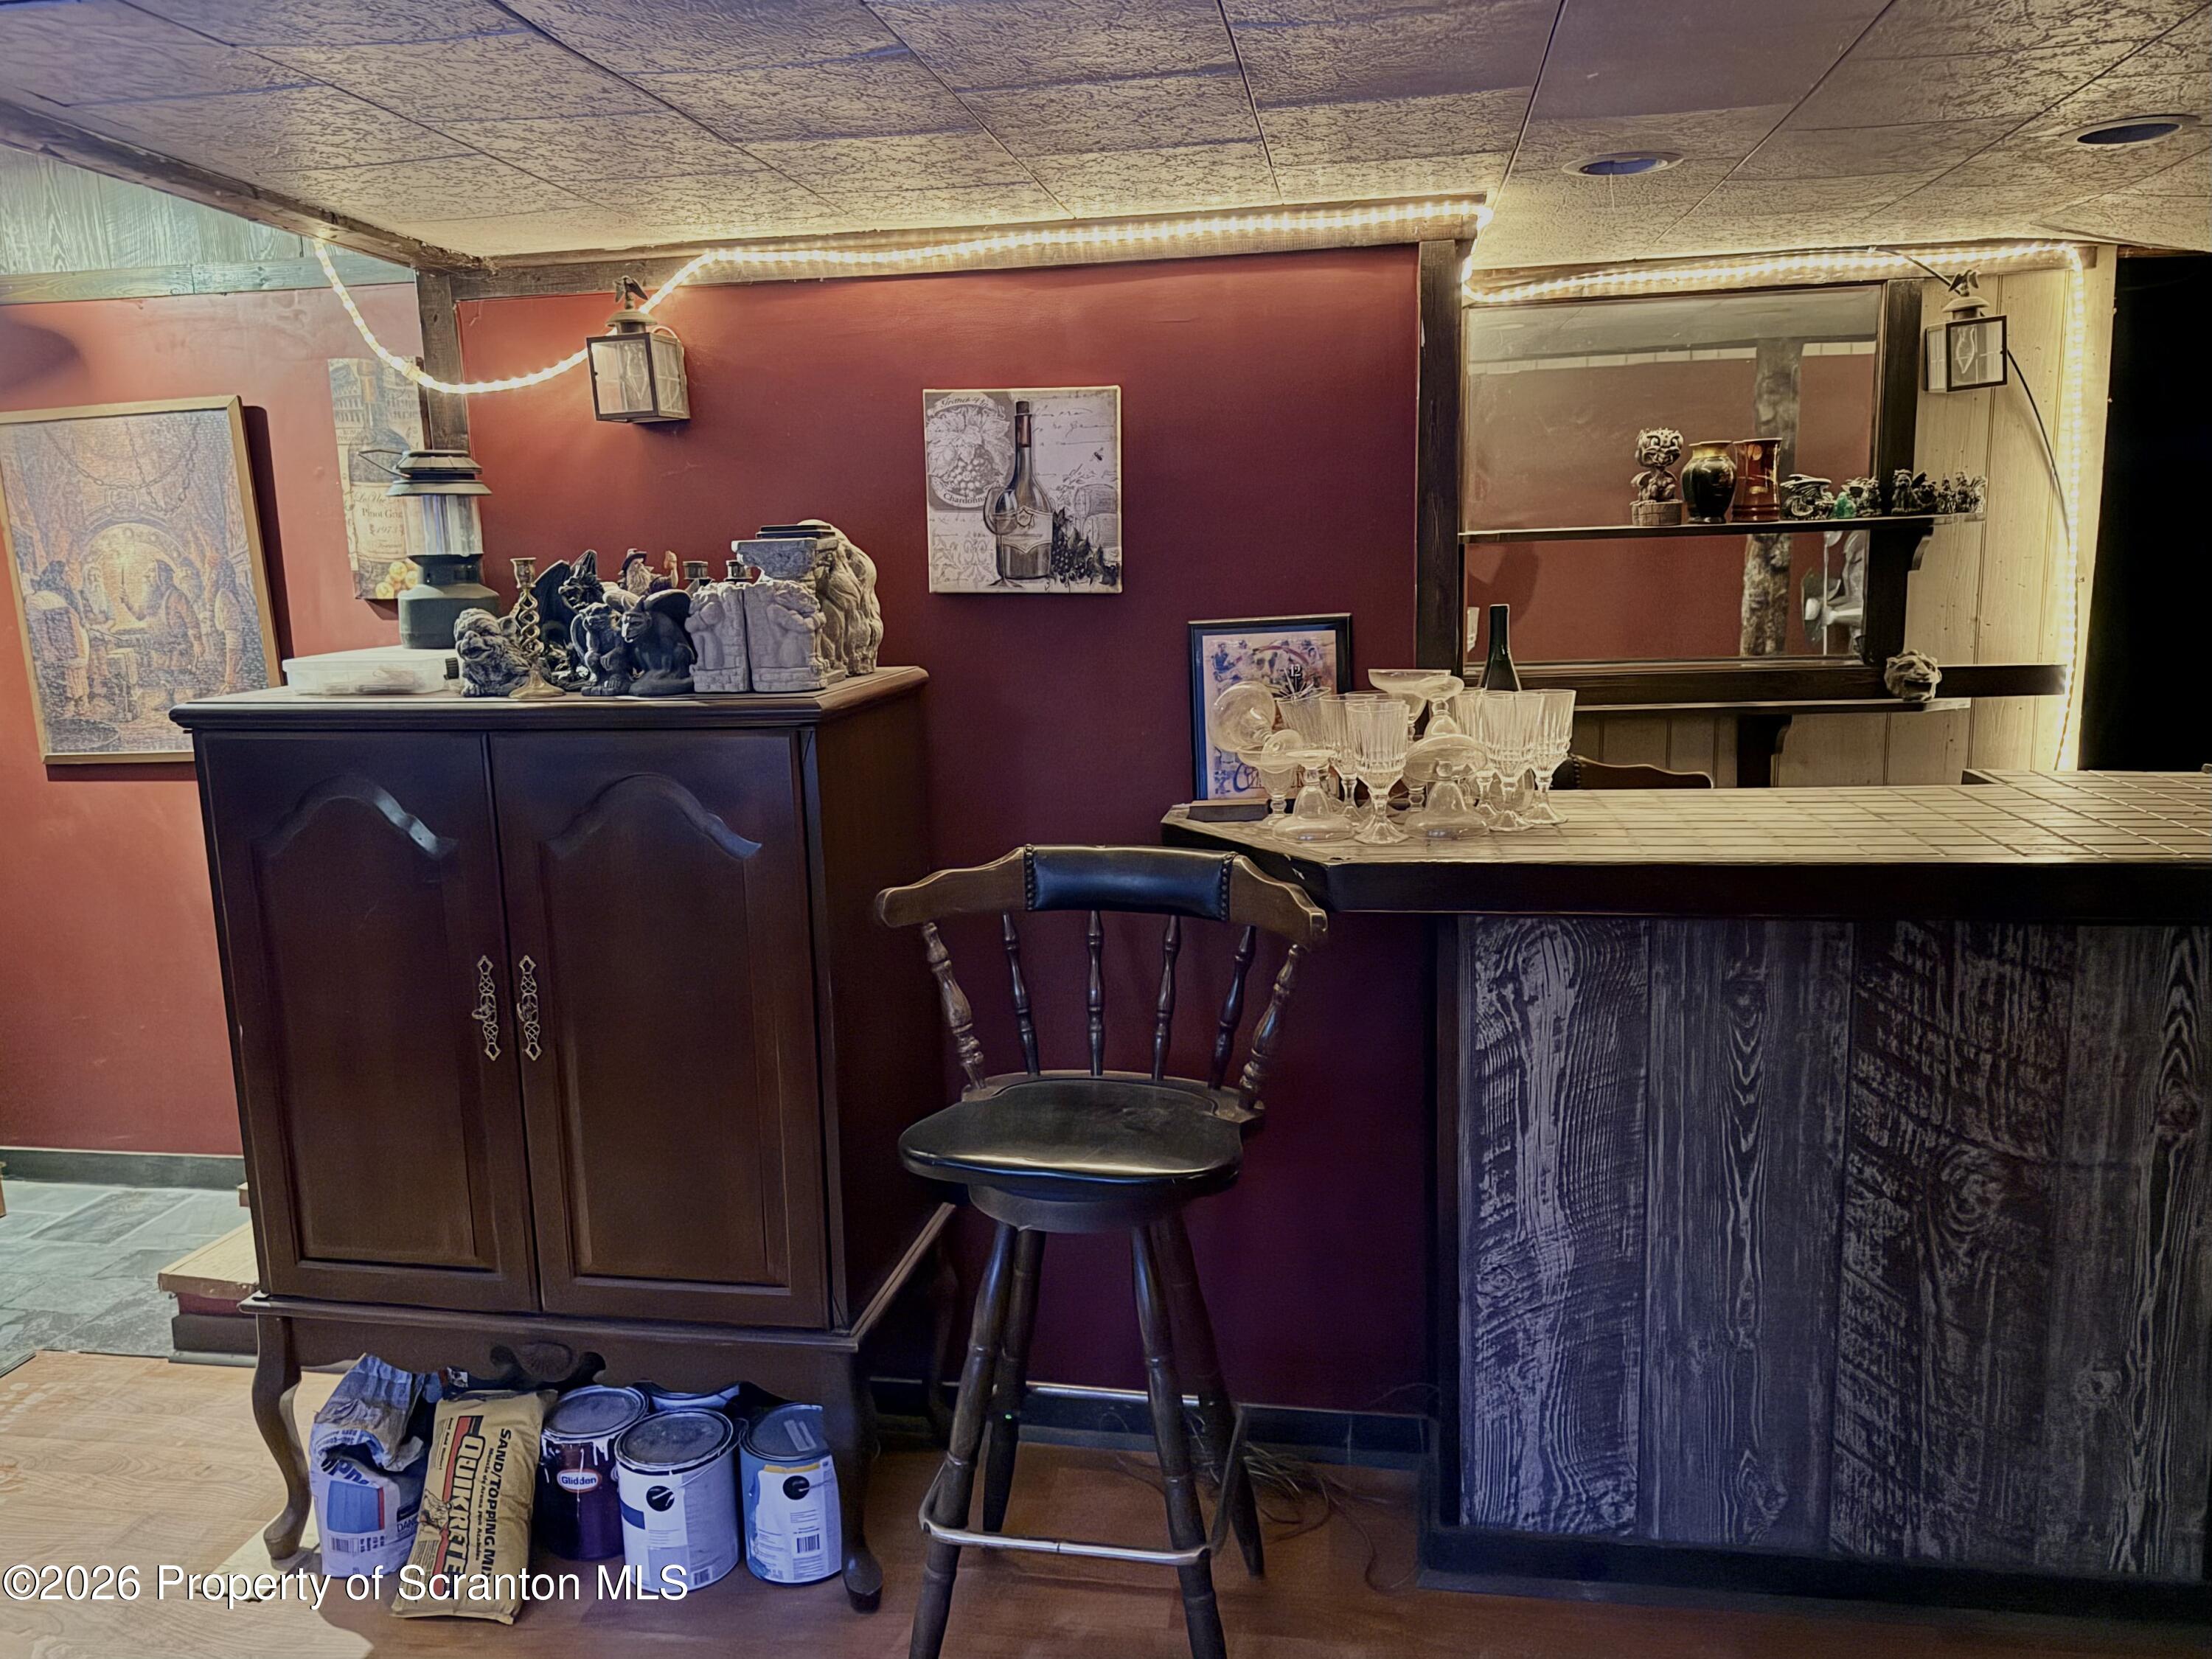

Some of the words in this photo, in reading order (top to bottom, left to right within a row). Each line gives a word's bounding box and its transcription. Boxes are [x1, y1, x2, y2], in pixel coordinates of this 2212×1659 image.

[943, 492, 987, 504] Chardonna
[1290, 664, 1301, 677] 12
[561, 1476, 597, 1485] Glidden
[442, 1434, 486, 1574] QUIKRETE
